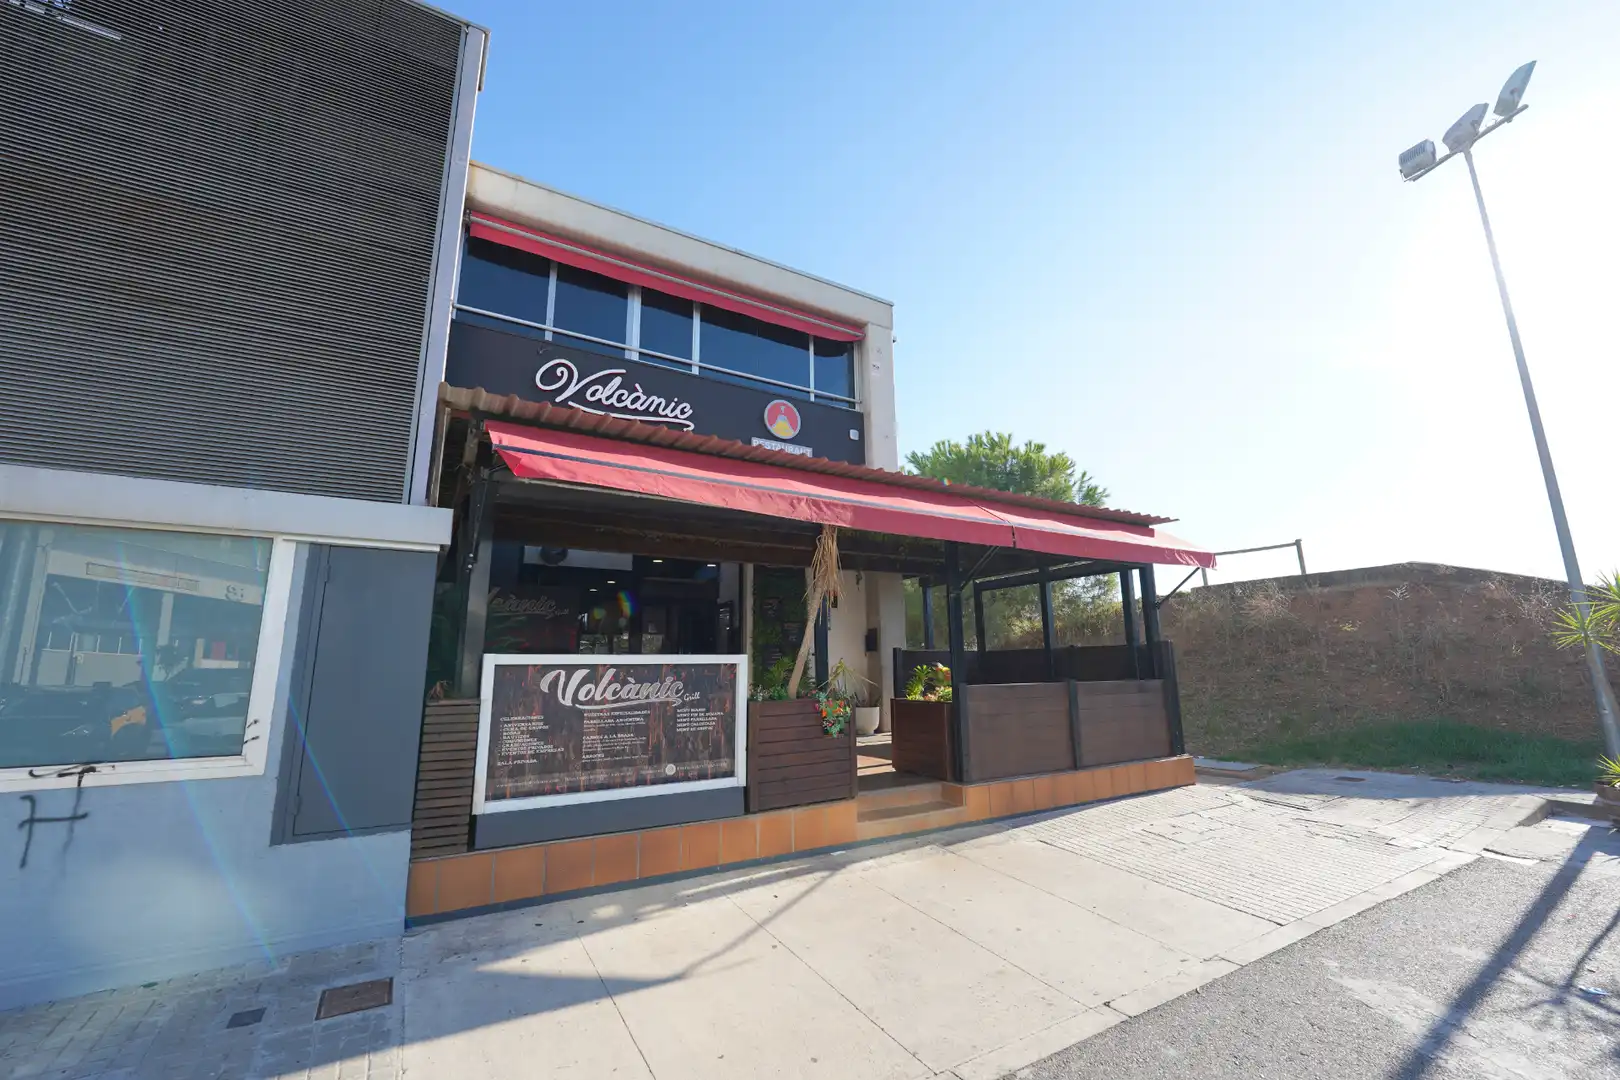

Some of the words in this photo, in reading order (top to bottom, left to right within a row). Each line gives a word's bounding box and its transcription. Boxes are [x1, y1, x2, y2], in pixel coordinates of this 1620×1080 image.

[535, 358, 693, 421] Volcànic
[540, 668, 685, 706] Volcànic
[684, 692, 700, 701] Grill
